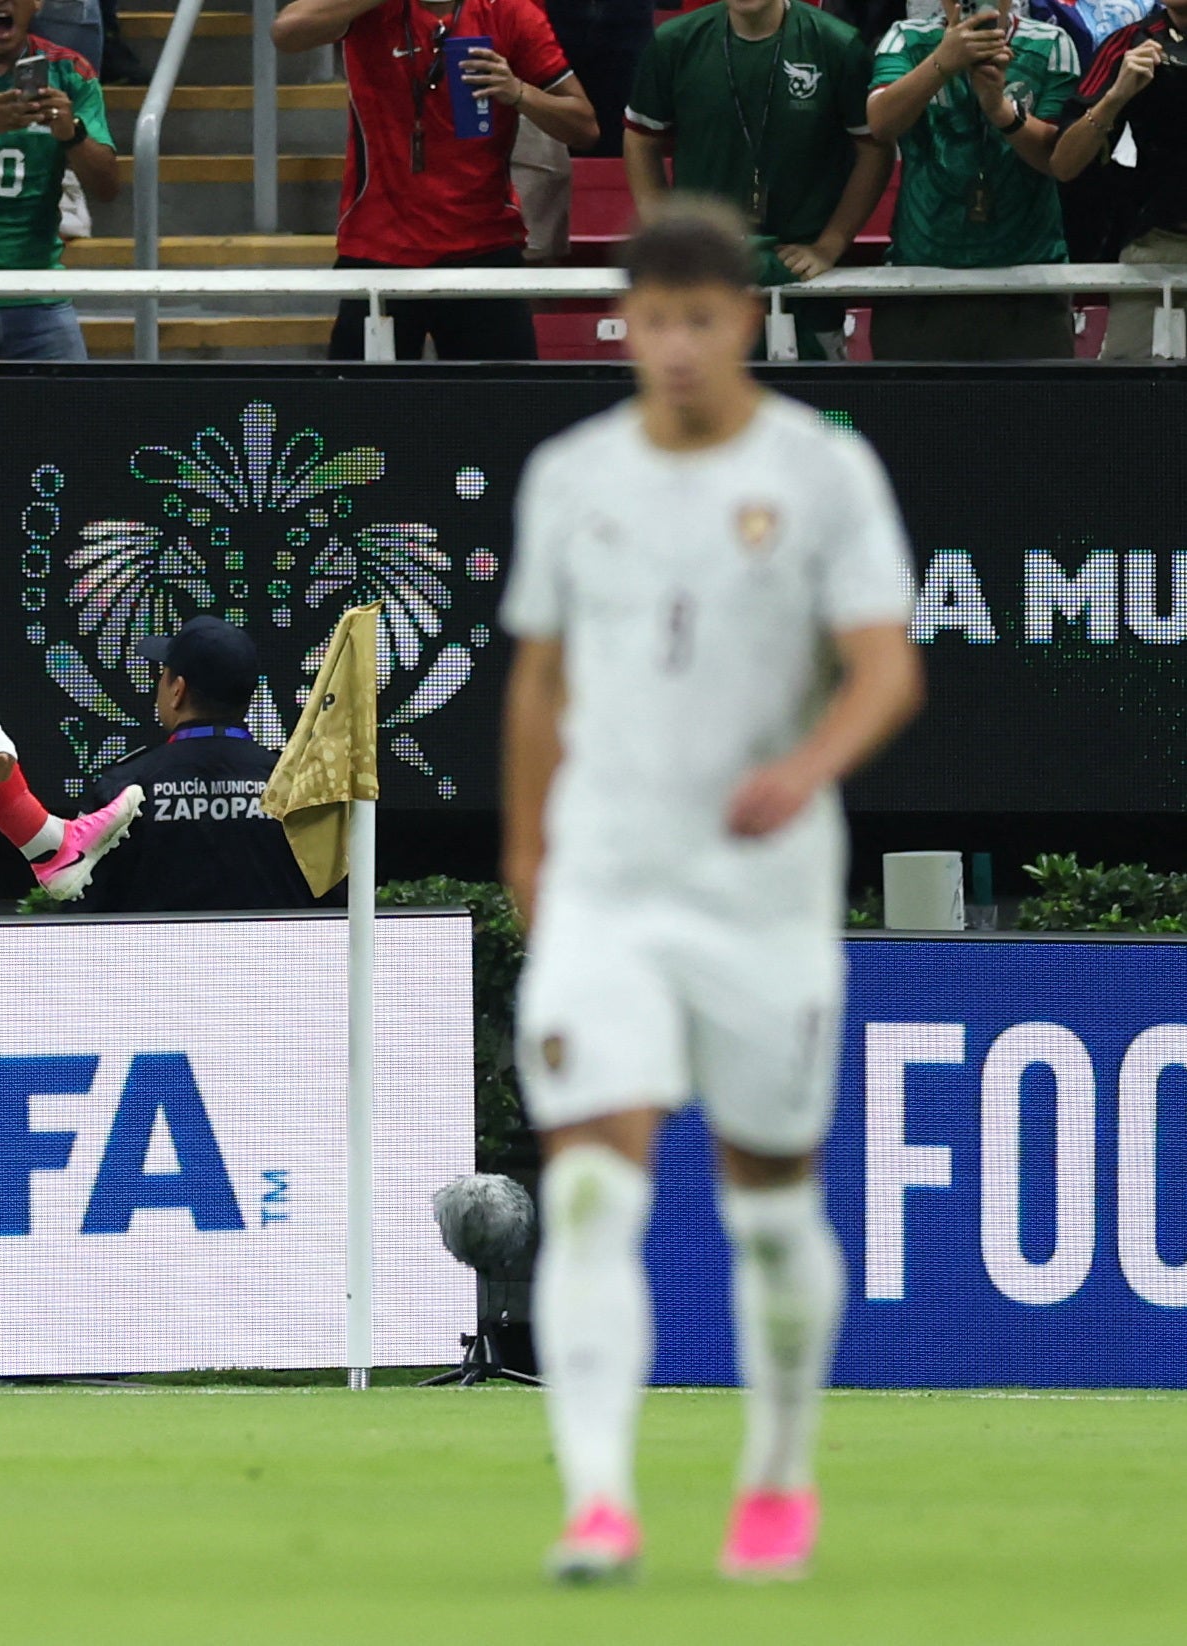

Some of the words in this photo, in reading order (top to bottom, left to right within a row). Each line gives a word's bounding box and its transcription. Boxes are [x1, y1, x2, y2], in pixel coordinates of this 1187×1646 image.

[894, 549, 1000, 645] A
[153, 777, 208, 796] POLICÍA
[211, 780, 267, 795] MUNICIP
[153, 797, 274, 822] ZAPOPA
[260, 1169, 290, 1229] TM
